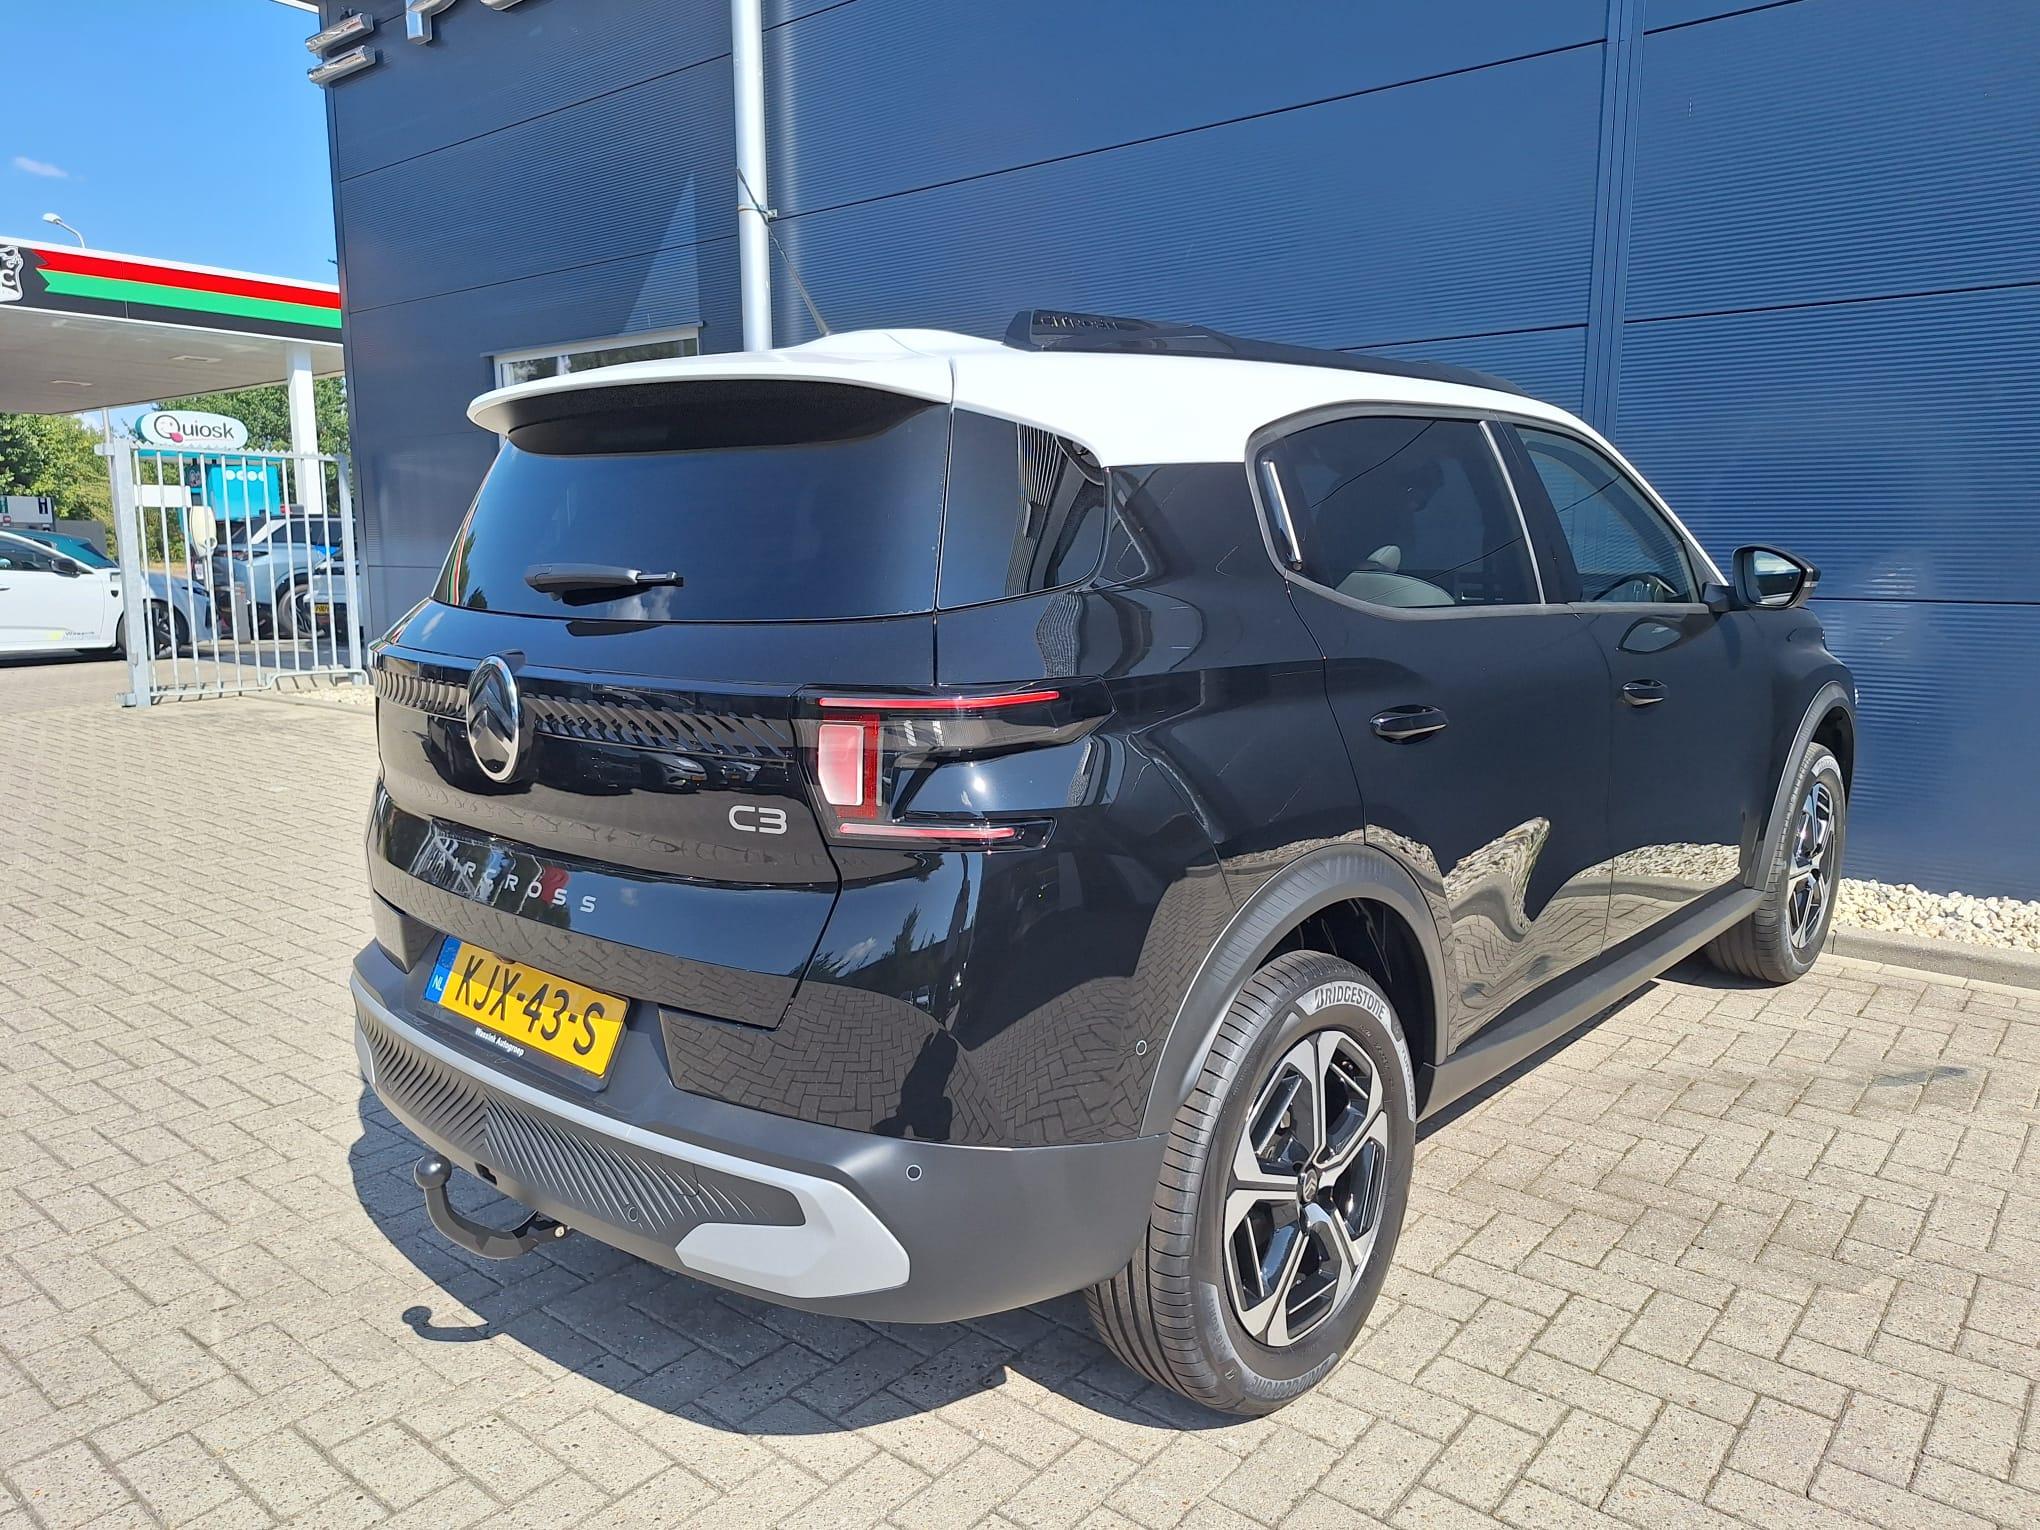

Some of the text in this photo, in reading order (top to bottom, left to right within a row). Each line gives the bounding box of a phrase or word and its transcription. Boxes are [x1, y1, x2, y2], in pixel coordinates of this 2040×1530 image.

[154, 414, 234, 443] Quiosk
[729, 805, 787, 835] C3
[436, 856, 597, 913] AIRCROSS
[432, 974, 444, 992] NL
[455, 955, 605, 1055] KJX-43-S
[1314, 985, 1386, 1020] BRIDGESTONE
[475, 1026, 525, 1058] Wassink Autogroep
